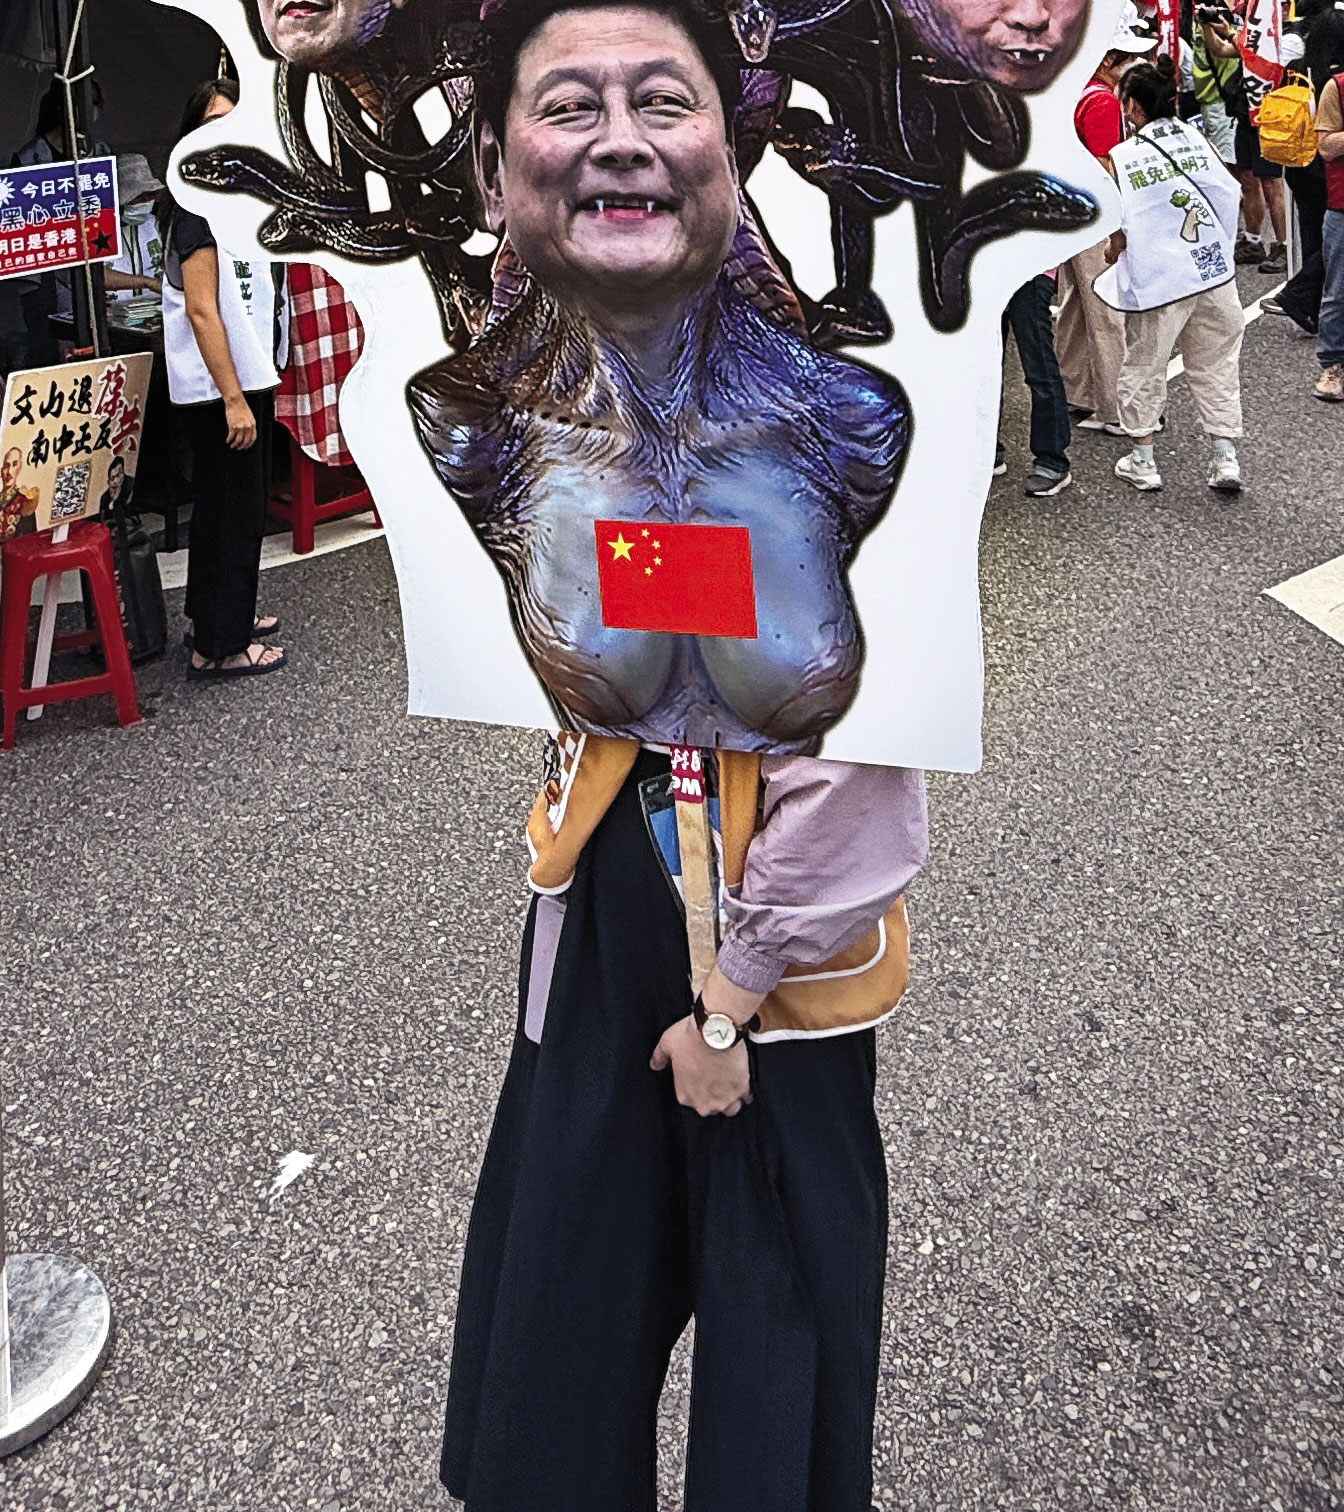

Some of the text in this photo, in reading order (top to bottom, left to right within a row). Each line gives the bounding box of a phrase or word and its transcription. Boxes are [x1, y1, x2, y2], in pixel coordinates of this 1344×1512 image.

[20, 172, 111, 199] 今日不罷免
[0, 194, 102, 233] 黑心立委
